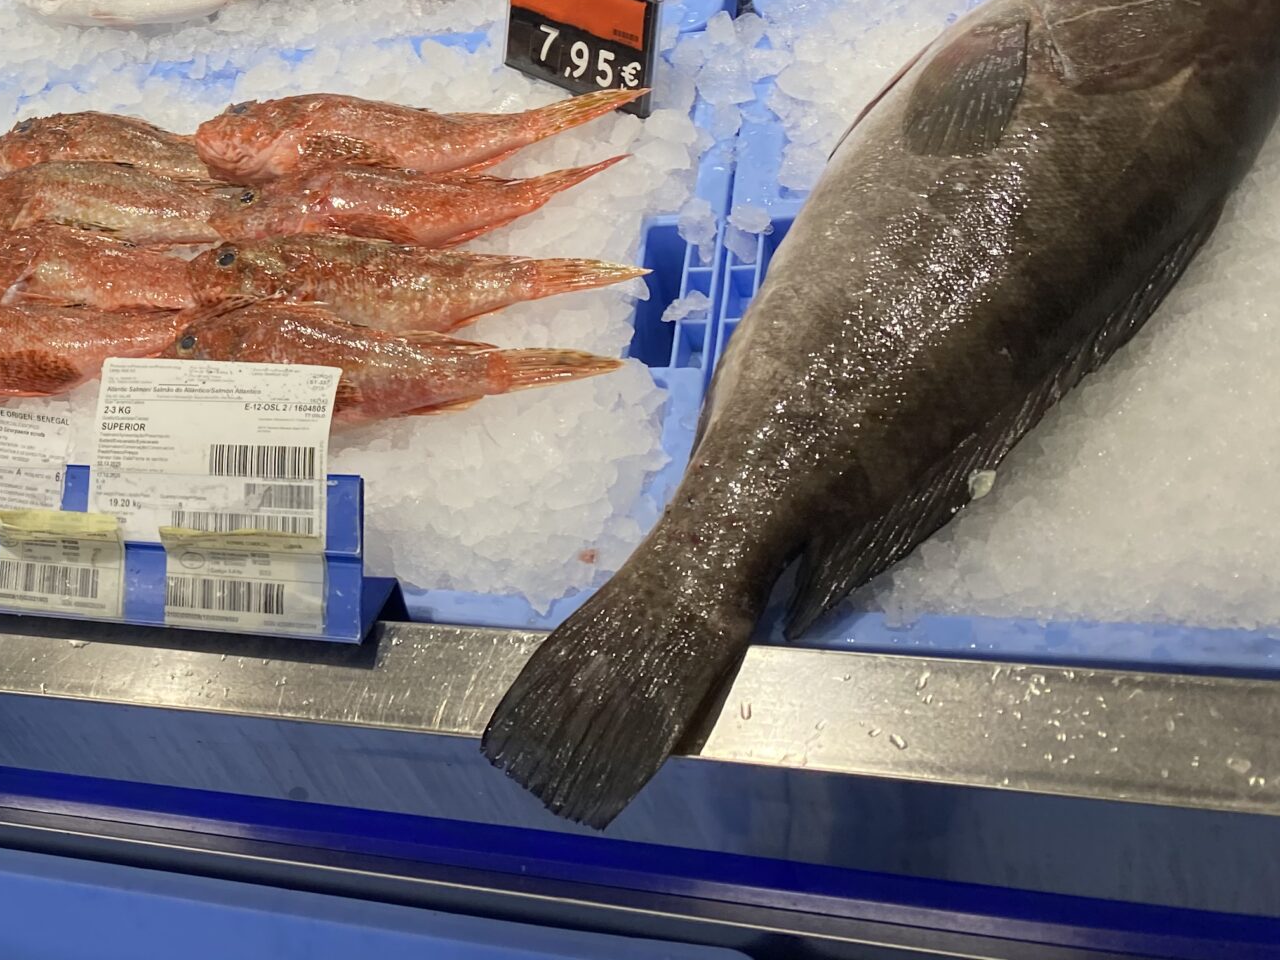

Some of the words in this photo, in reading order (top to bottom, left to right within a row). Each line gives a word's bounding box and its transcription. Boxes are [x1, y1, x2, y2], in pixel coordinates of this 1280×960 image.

[539, 24, 616, 88] 7,95
[104, 406, 116, 414] 2-3
[118, 406, 131, 415] KG
[244, 403, 279, 412] E-12-OSL
[36, 415, 70, 426] SENEGAL
[101, 422, 146, 431] SUPERIOR
